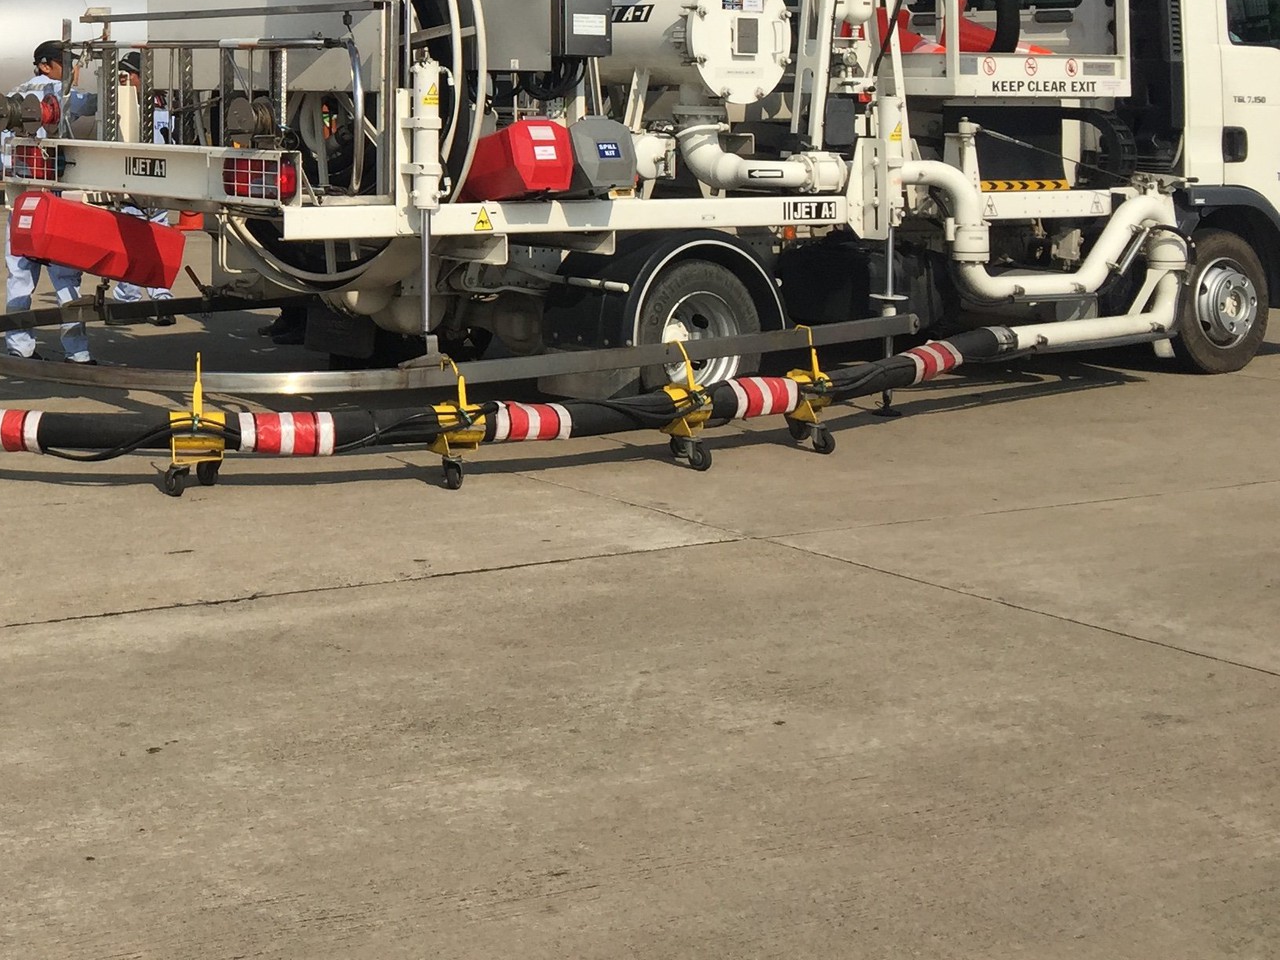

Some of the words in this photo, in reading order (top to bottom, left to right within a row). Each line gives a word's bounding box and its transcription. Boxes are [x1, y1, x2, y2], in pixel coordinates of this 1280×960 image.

[622, 6, 650, 22] A-1
[992, 80, 1025, 92] KEEP
[1027, 80, 1067, 93] CLEAR
[1071, 80, 1097, 93] EXIT
[133, 158, 151, 175] JET
[793, 202, 817, 219] JET
